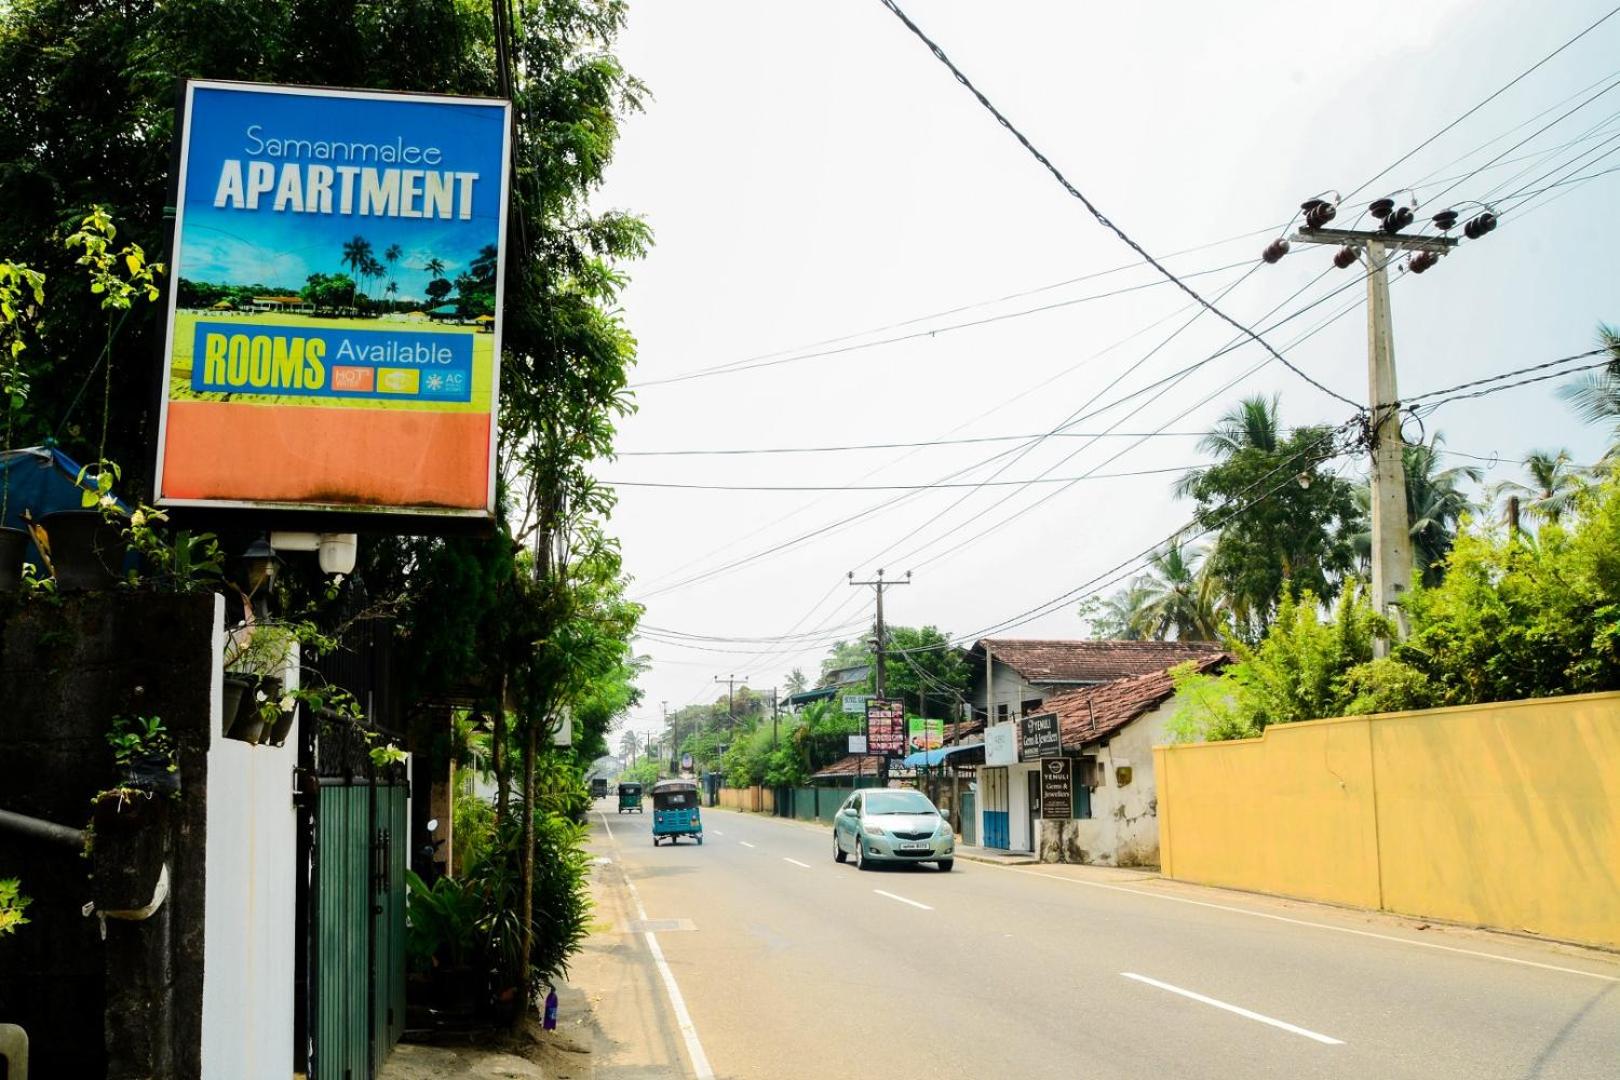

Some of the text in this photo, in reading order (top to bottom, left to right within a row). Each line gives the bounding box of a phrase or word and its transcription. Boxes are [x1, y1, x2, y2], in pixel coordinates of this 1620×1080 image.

[244, 124, 443, 166] Samanmalee
[213, 159, 480, 221] APARTMENT
[203, 333, 453, 390] ROOMS Available
[445, 373, 463, 384] AC
